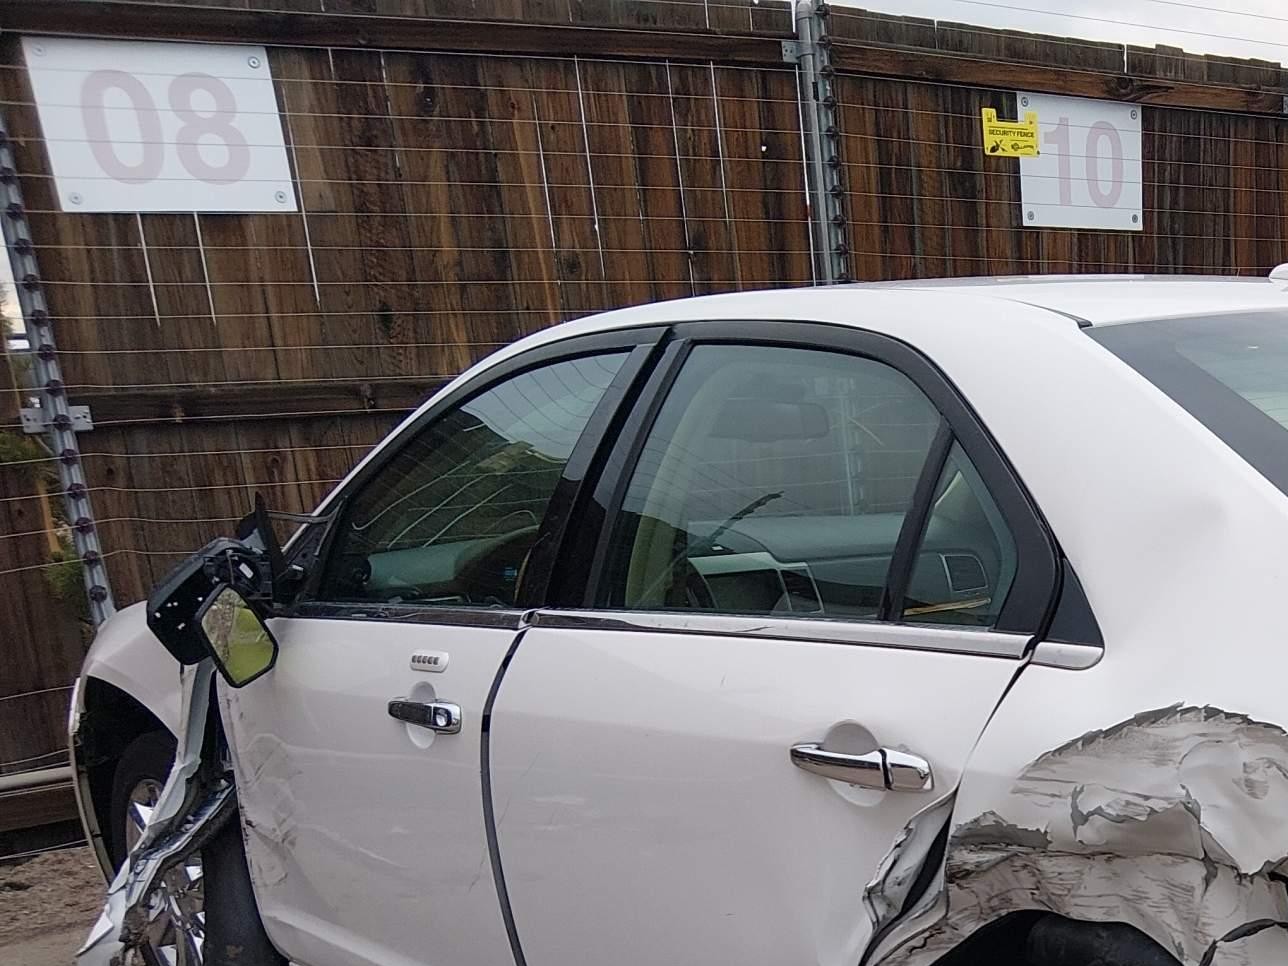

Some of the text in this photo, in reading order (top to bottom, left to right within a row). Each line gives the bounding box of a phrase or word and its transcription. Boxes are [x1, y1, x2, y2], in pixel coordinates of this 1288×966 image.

[80, 69, 251, 186] 08
[988, 128, 1035, 138] SECURITY FENCE
[1043, 116, 1124, 208] 10
